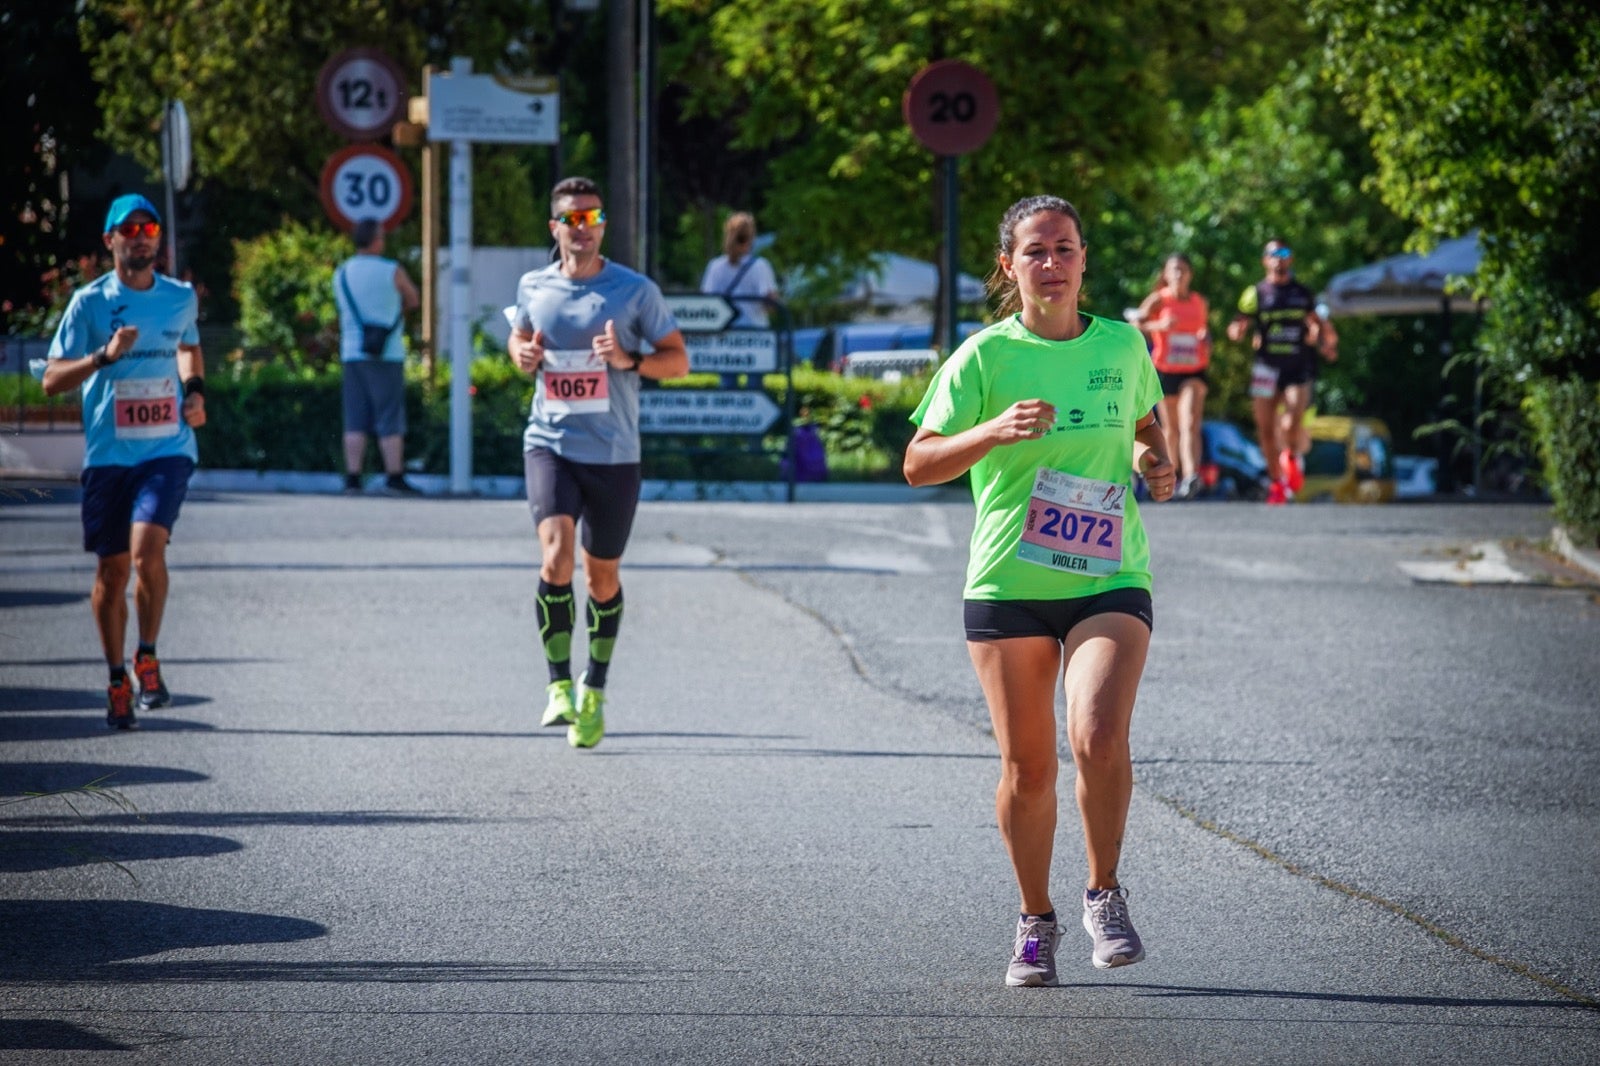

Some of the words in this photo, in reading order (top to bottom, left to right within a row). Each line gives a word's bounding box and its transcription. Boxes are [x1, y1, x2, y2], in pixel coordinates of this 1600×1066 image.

[929, 91, 977, 123] 20
[344, 171, 391, 208] 30
[551, 377, 599, 397] 1067
[1089, 376, 1123, 385] ATLÉTICA
[125, 403, 172, 424] 1082
[1039, 507, 1114, 548] 2072
[1051, 553, 1088, 571] VIOLETA
